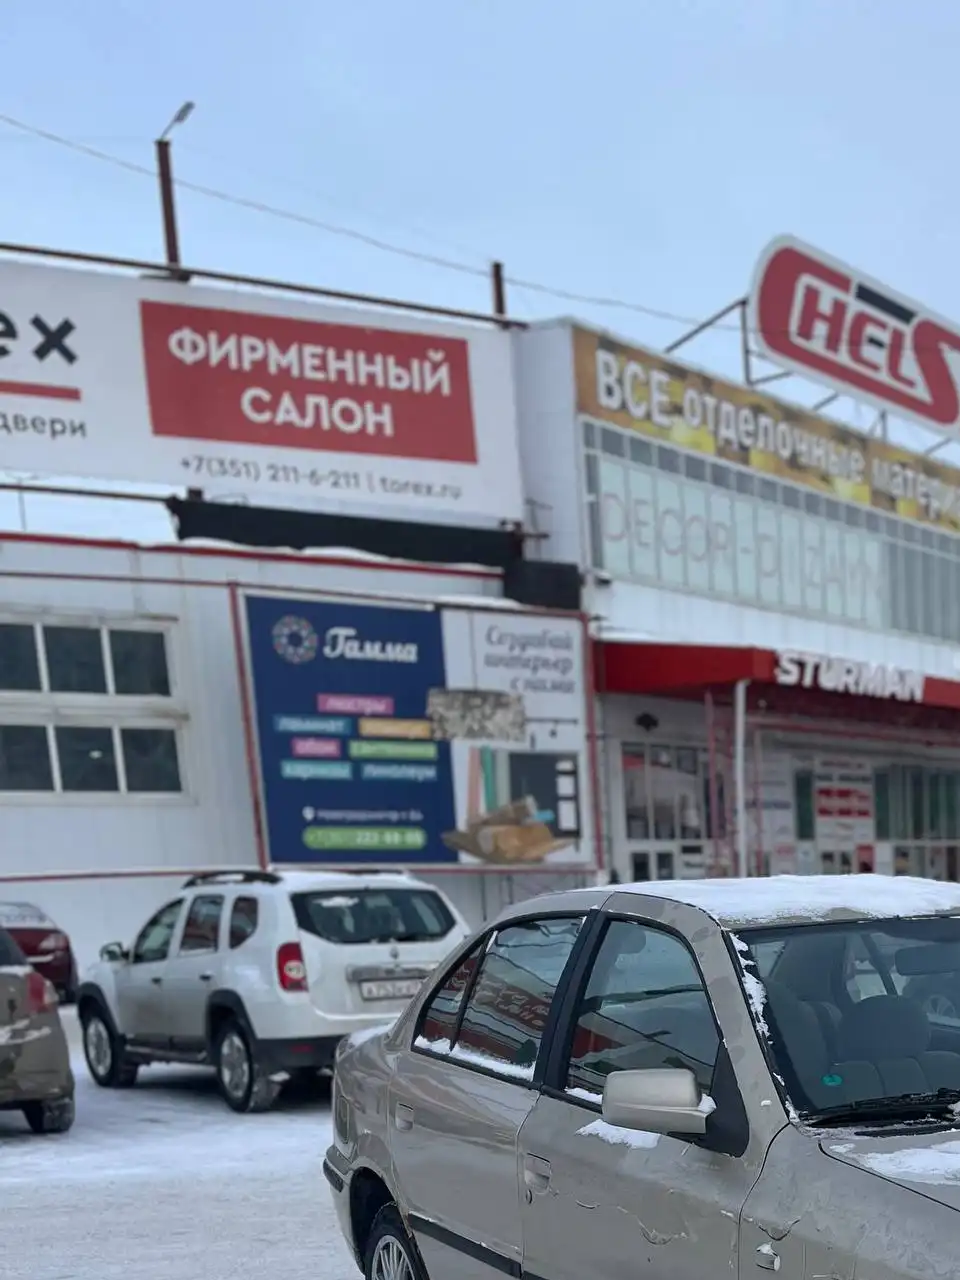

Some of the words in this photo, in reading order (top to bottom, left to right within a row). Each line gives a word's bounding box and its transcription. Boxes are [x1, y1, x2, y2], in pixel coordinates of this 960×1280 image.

[168, 326, 452, 397] ФИРМЕННЫЙ
[240, 386, 395, 437] САЛОН
[595, 348, 672, 427] ВСЕ
[683, 387, 866, 482] отделочные
[180, 454, 262, 483] +7(351)
[267, 462, 361, 491] 211-6-211
[380, 474, 463, 501] torex.ru
[323, 626, 419, 663] Гамма
[774, 649, 926, 702] STURMAN
